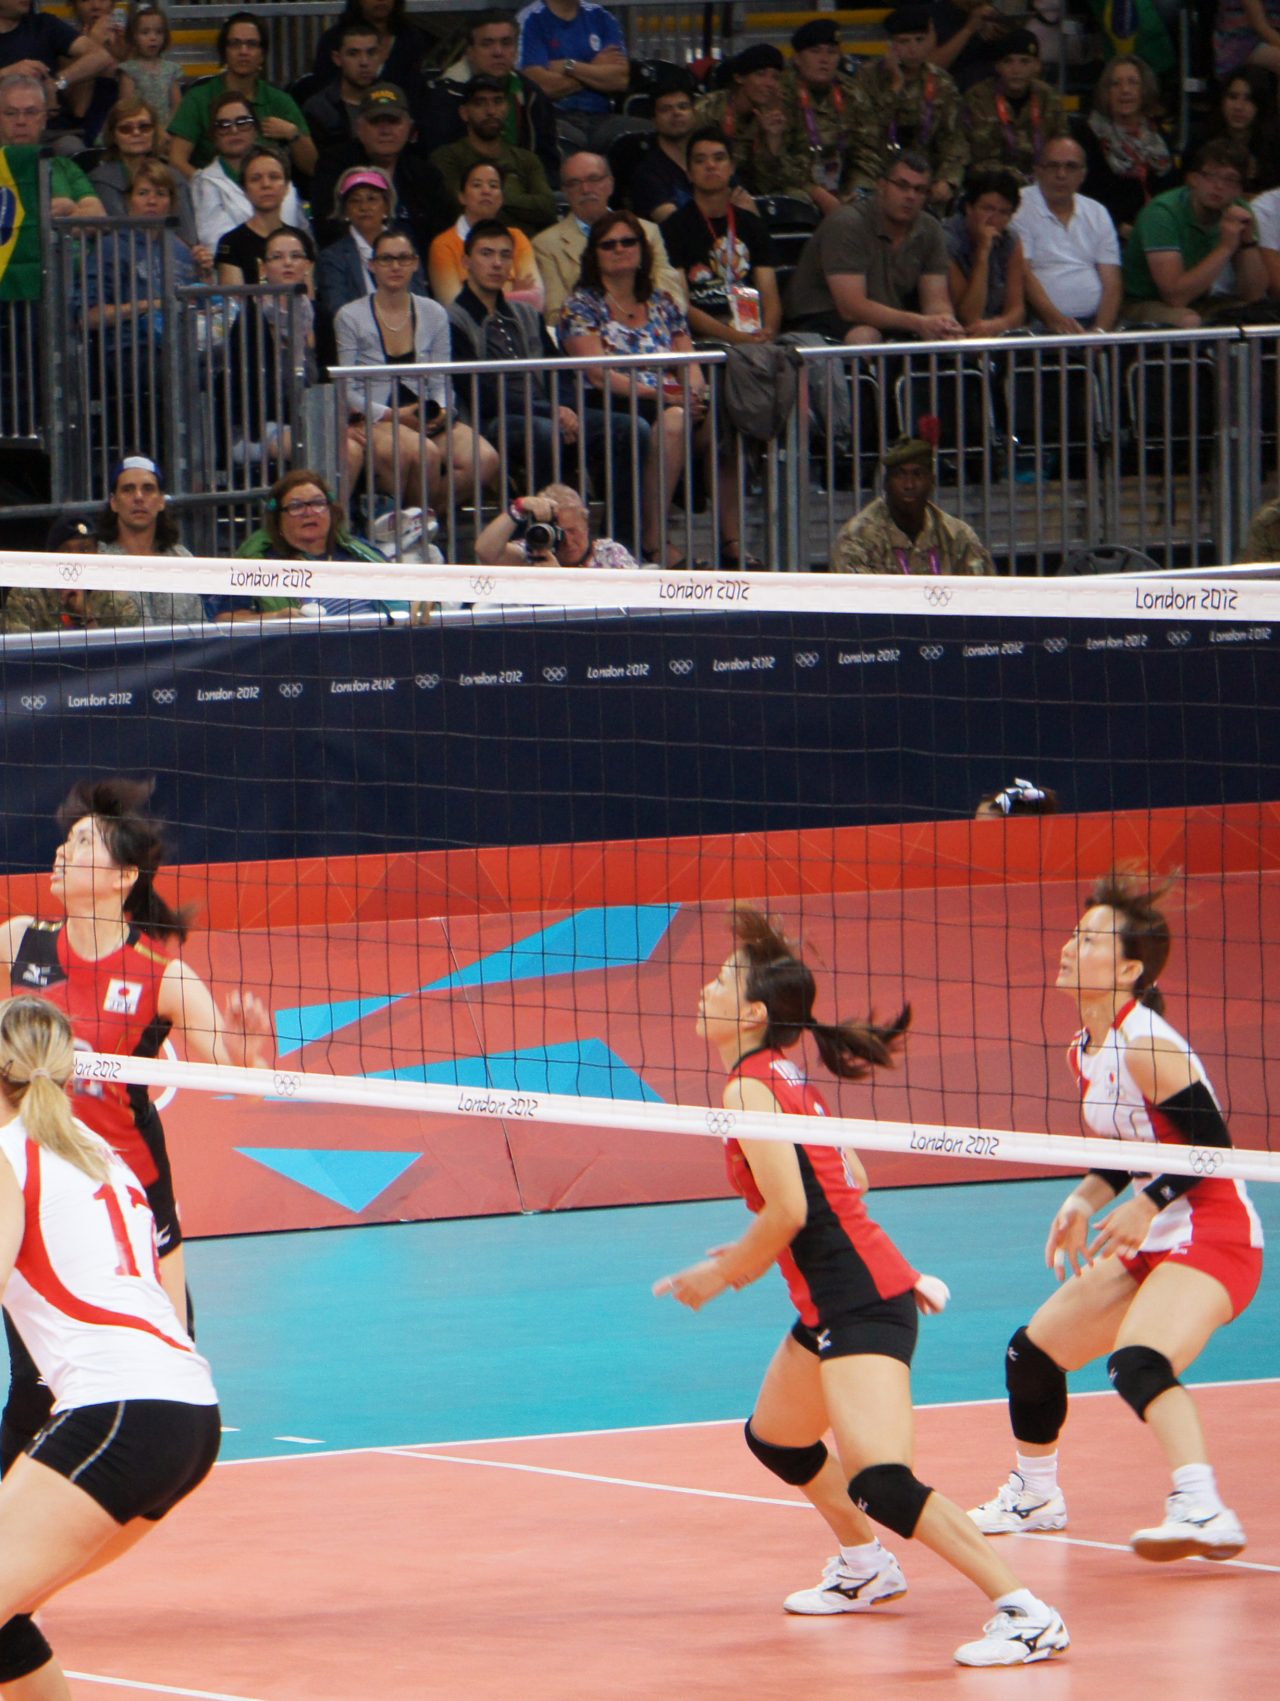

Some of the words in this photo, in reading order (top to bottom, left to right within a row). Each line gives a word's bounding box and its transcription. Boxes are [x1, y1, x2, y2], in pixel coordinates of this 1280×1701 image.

[230, 566, 279, 587] London
[282, 568, 312, 588] 2012
[659, 577, 713, 599] London
[717, 579, 750, 600] 2012
[1136, 586, 1196, 610] London
[1201, 588, 1238, 611] 2012
[713, 658, 750, 671] London
[838, 651, 875, 664] London
[459, 672, 497, 686] London
[499, 670, 522, 683] 2012
[587, 665, 624, 679] London
[626, 664, 649, 676] 2012
[197, 688, 233, 701] London
[236, 686, 260, 699] 2012
[331, 680, 370, 693] London
[68, 695, 107, 707] London
[92, 1060, 122, 1079] 2012
[457, 1091, 506, 1114] London
[507, 1097, 538, 1117] 2012
[910, 1130, 964, 1153] London
[965, 1134, 1000, 1156] 2012
